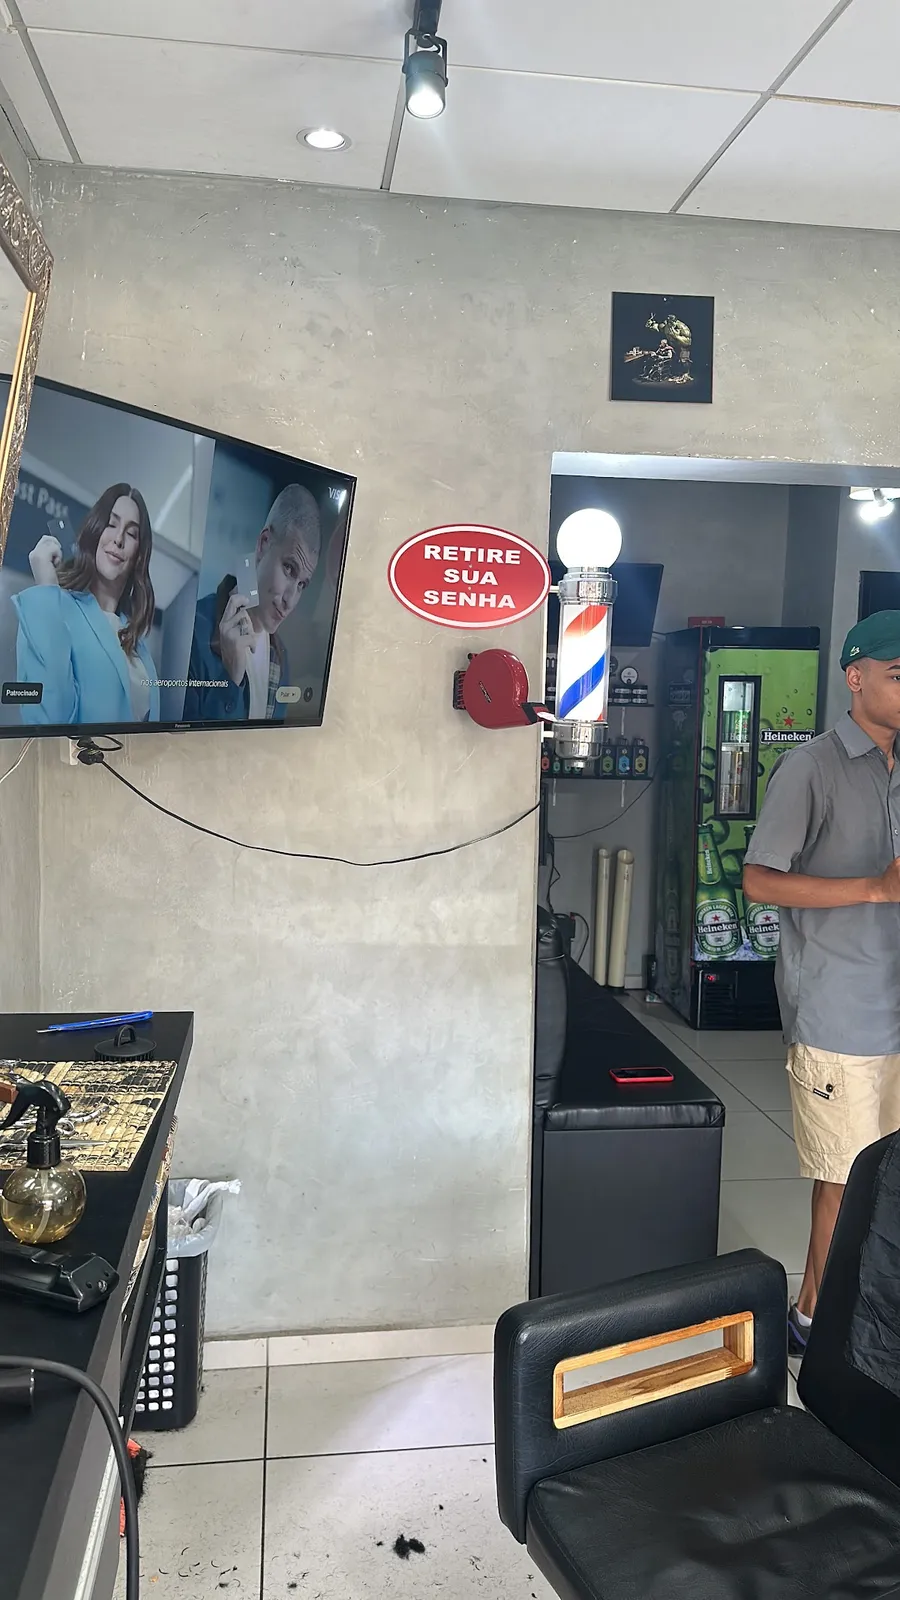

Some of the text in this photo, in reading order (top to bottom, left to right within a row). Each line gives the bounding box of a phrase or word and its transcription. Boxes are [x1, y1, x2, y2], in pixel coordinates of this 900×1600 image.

[424, 544, 521, 565] RETIRE
[443, 568, 499, 586] SUA
[423, 590, 516, 609] SENHA
[140, 679, 229, 688] nos aeroportos internacionais
[5, 689, 39, 697] Patrocinado
[763, 731, 812, 742] Heineken
[697, 923, 738, 933] Heineken
[749, 923, 780, 934] Heinek
